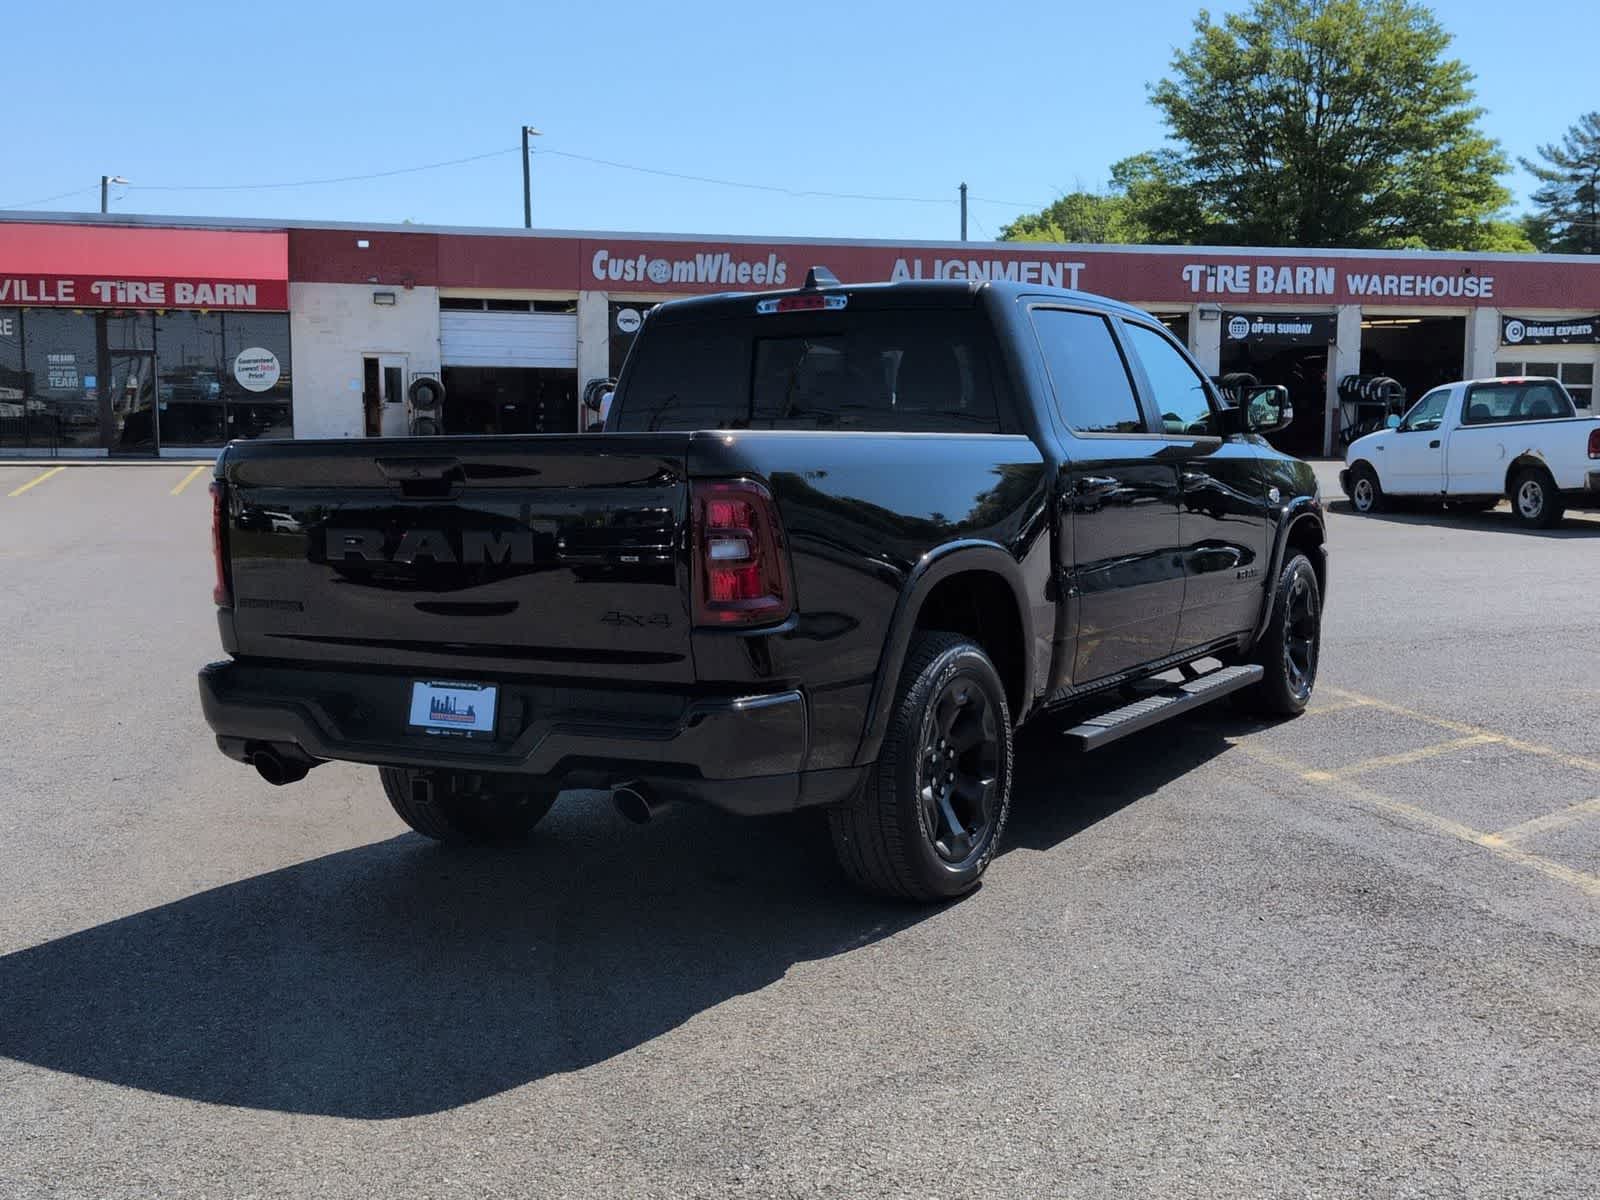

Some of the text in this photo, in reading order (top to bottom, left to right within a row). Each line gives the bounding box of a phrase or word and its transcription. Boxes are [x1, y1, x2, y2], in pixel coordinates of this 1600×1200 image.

[889, 259, 1086, 292] ALIGNMENT
[1256, 266, 1335, 295] BARN
[1346, 274, 1494, 298] WAREHOUSE
[174, 282, 257, 306] BARN
[1251, 322, 1313, 335] OPEN SUNDAY
[1526, 324, 1593, 337] BRAKE EXPERTS
[49, 377, 79, 387] TEAM
[326, 528, 534, 563] RAM
